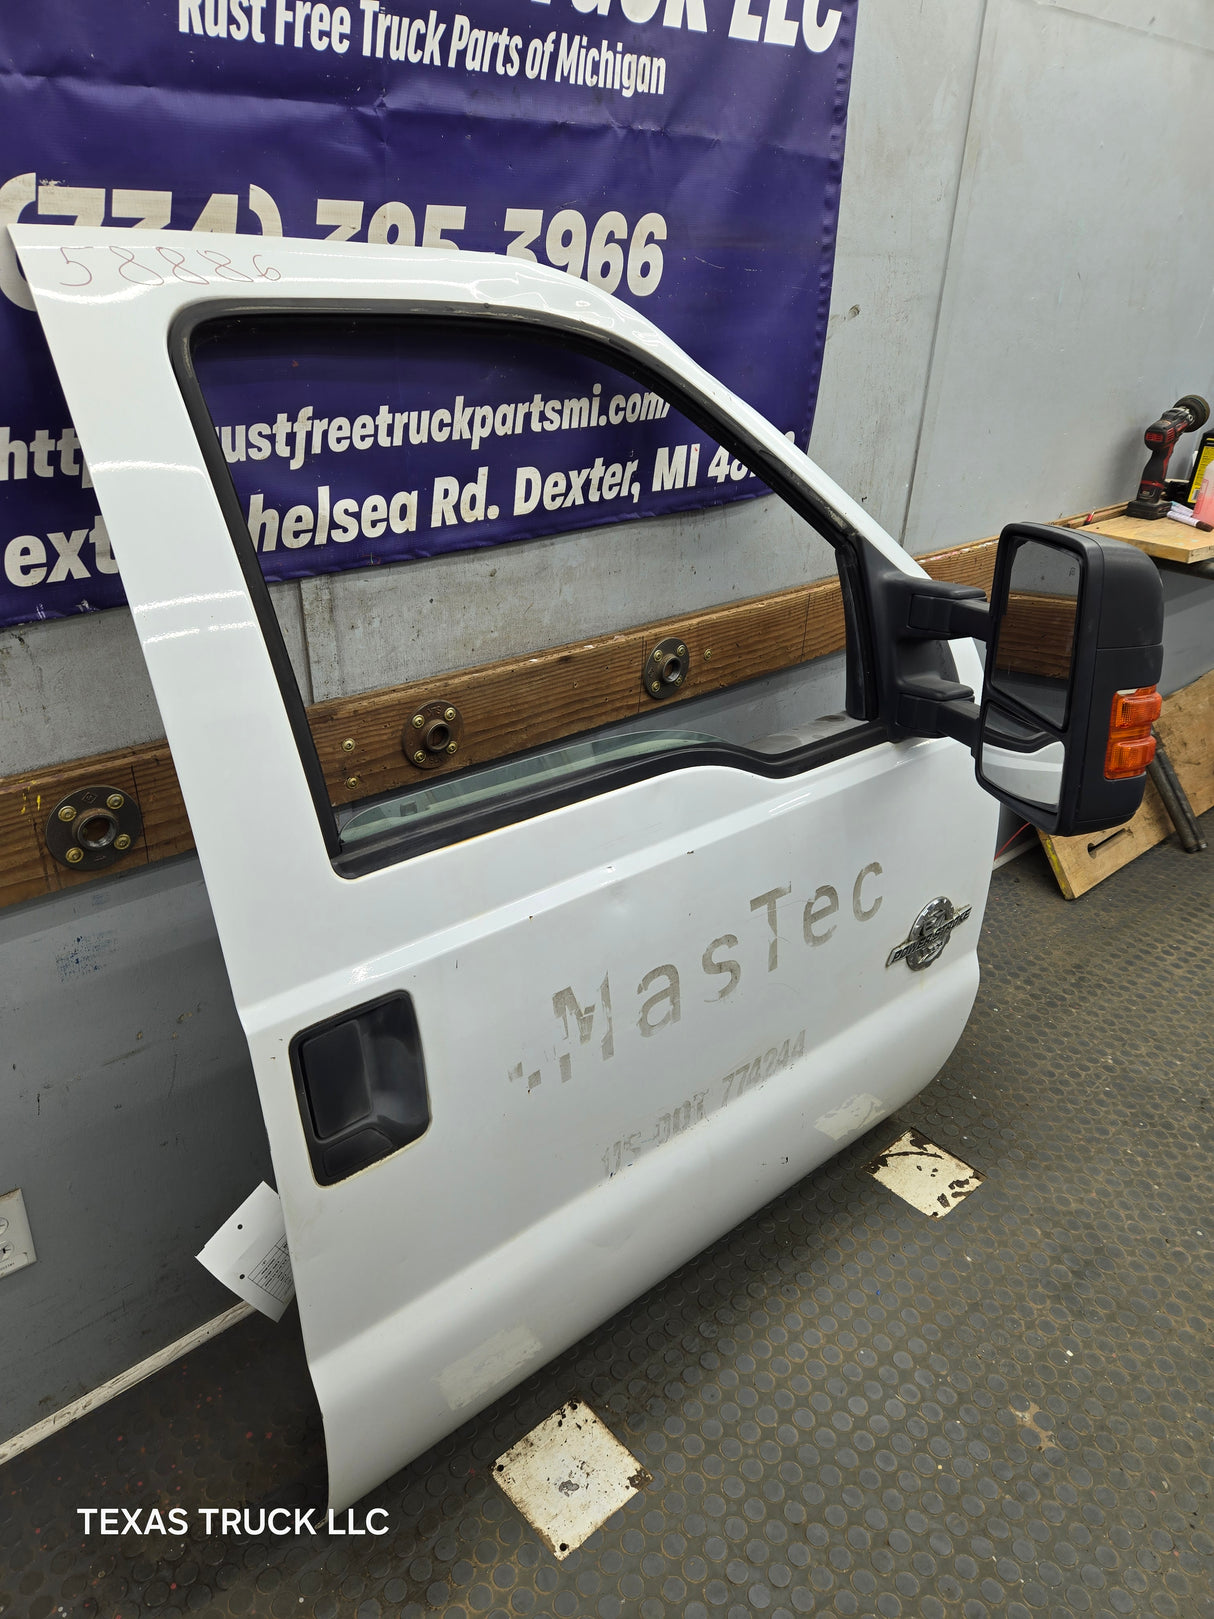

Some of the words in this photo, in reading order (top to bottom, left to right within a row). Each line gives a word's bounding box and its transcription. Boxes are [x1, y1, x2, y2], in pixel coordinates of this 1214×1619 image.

[178, 0, 266, 44] Rust
[275, 0, 351, 53] Free
[360, 0, 447, 66] Truck
[447, 14, 520, 76] Parts
[525, 31, 557, 81] of
[555, 33, 666, 97] Michigan
[431, 466, 500, 527] Rd.
[513, 457, 641, 503] Dexter,
[652, 443, 700, 492] MI
[552, 862, 883, 1061] MasTec
